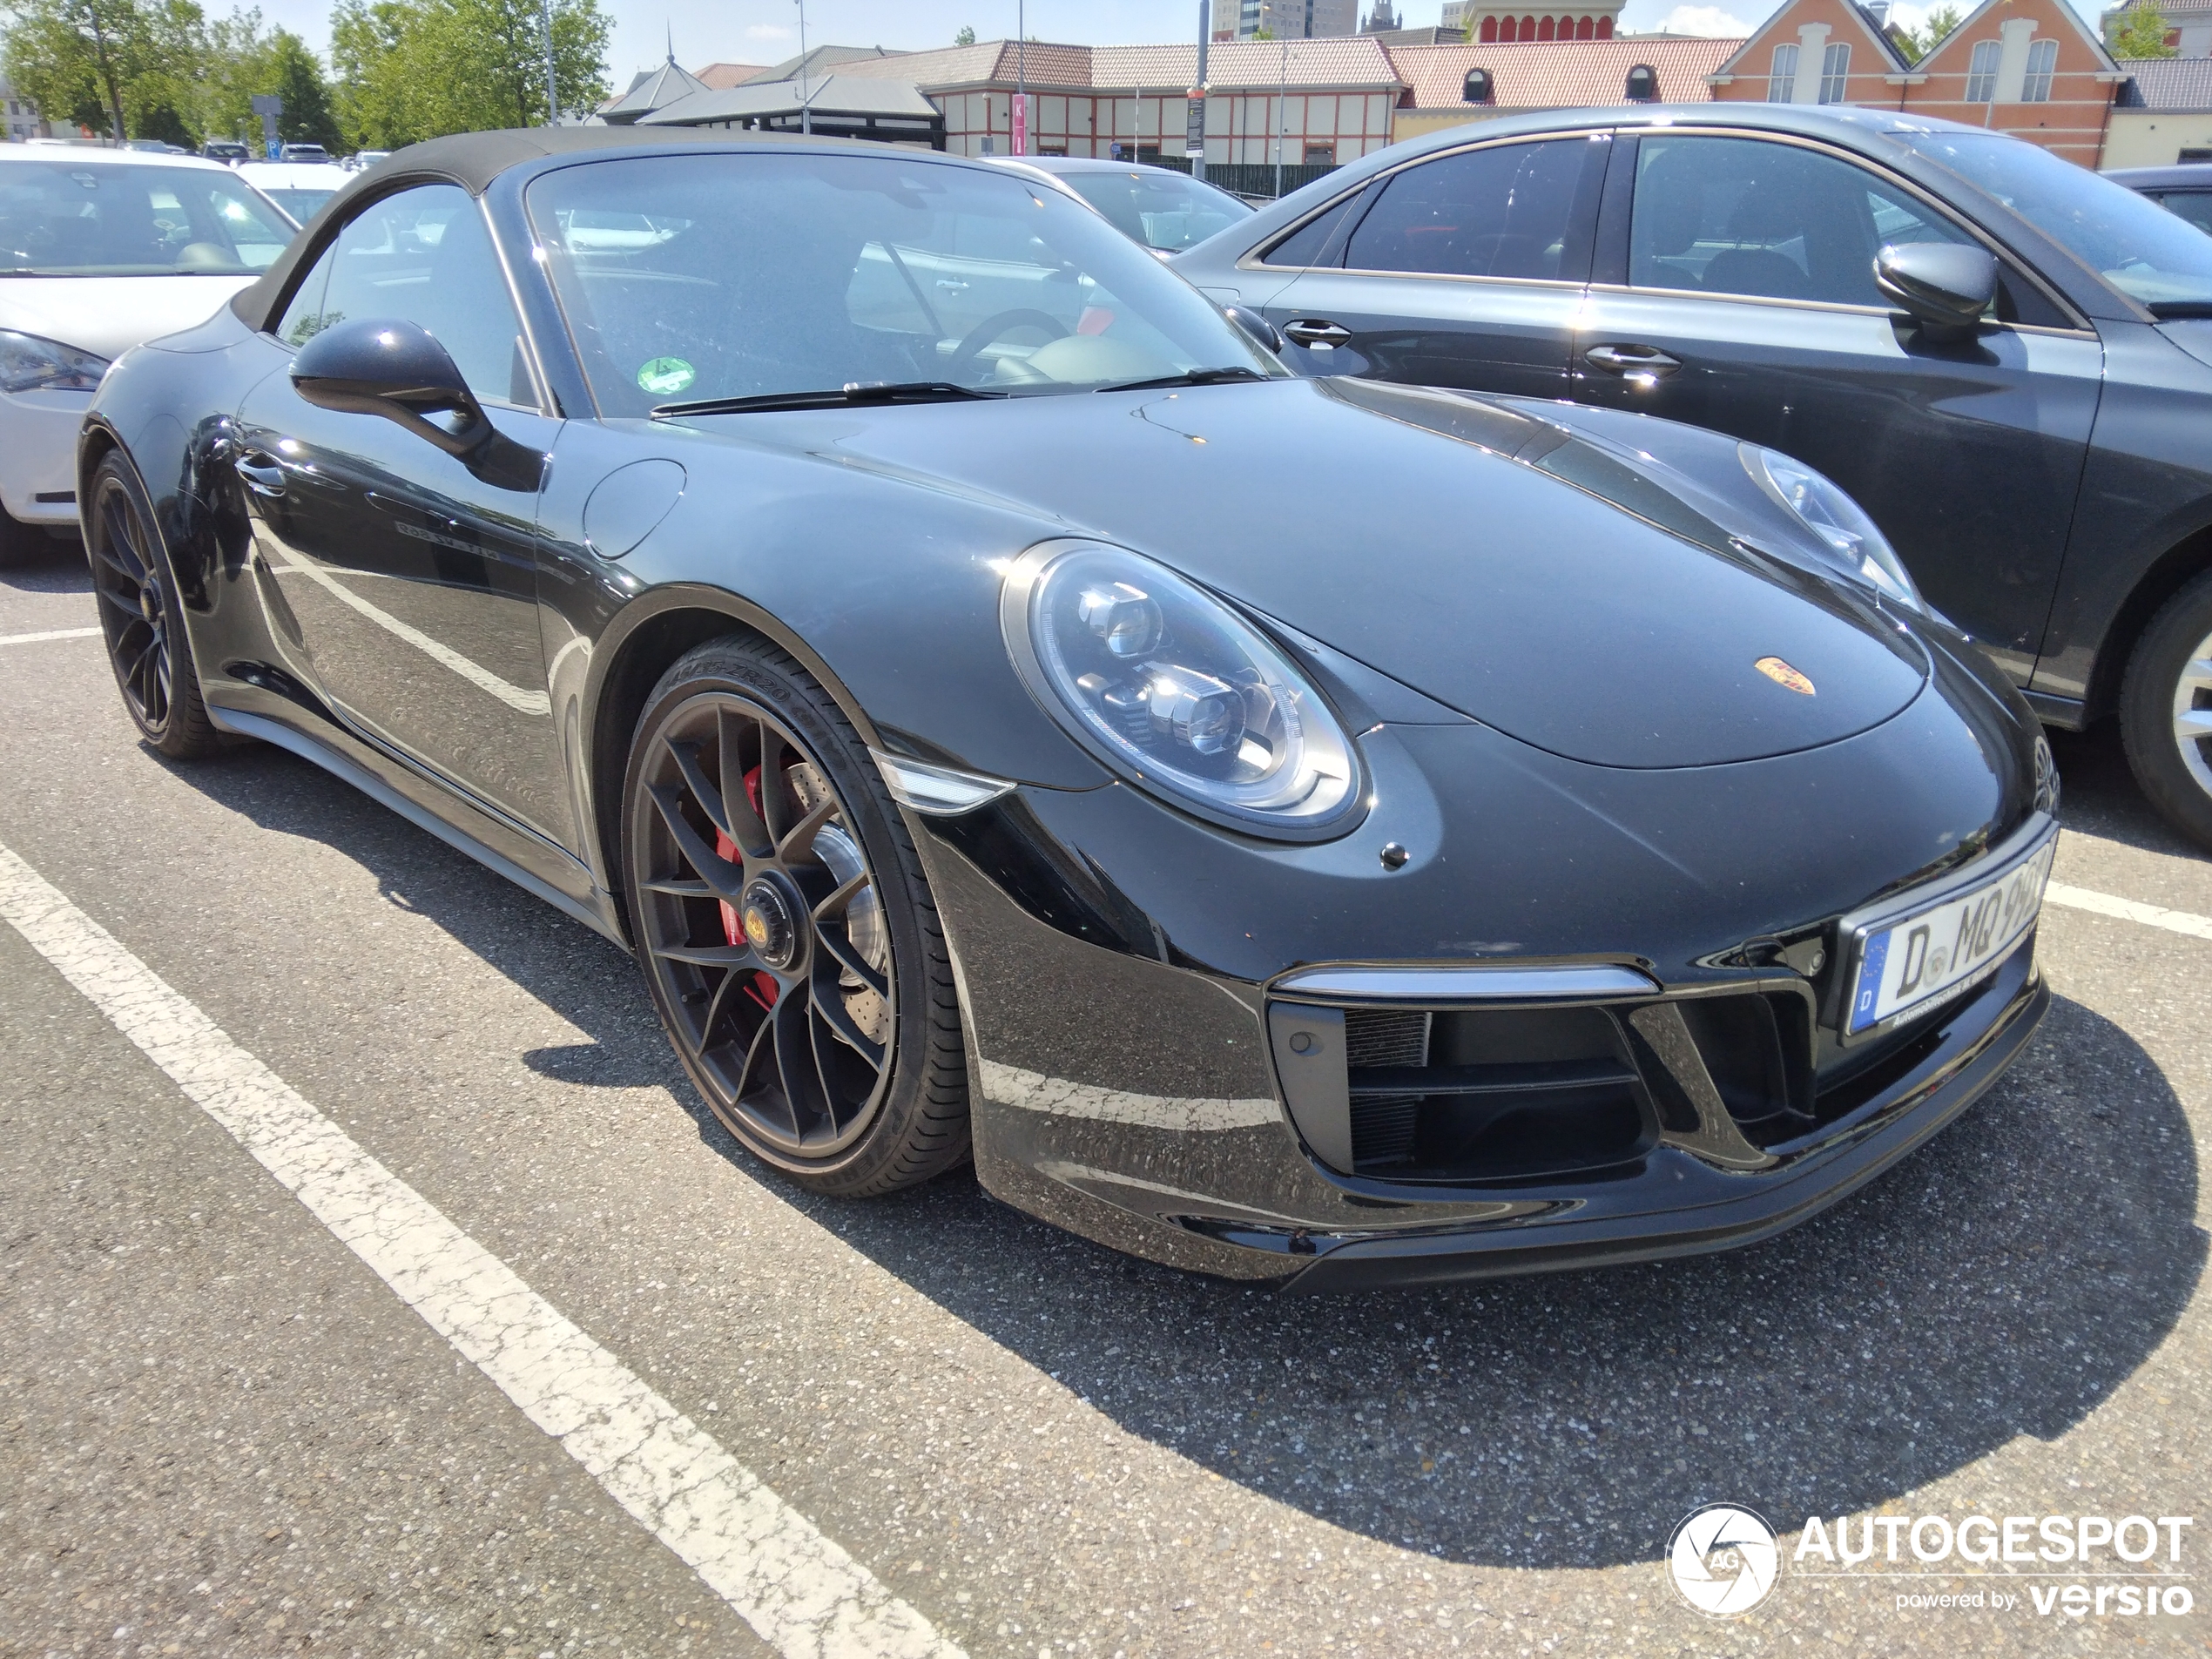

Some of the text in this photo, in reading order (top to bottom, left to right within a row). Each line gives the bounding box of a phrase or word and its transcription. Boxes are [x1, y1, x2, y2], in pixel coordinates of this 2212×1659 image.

[1015, 104, 1022, 117] K
[269, 142, 277, 152] P
[1896, 924, 1931, 1000] D
[1950, 887, 2003, 974] MQ
[1860, 989, 1872, 1011] D
